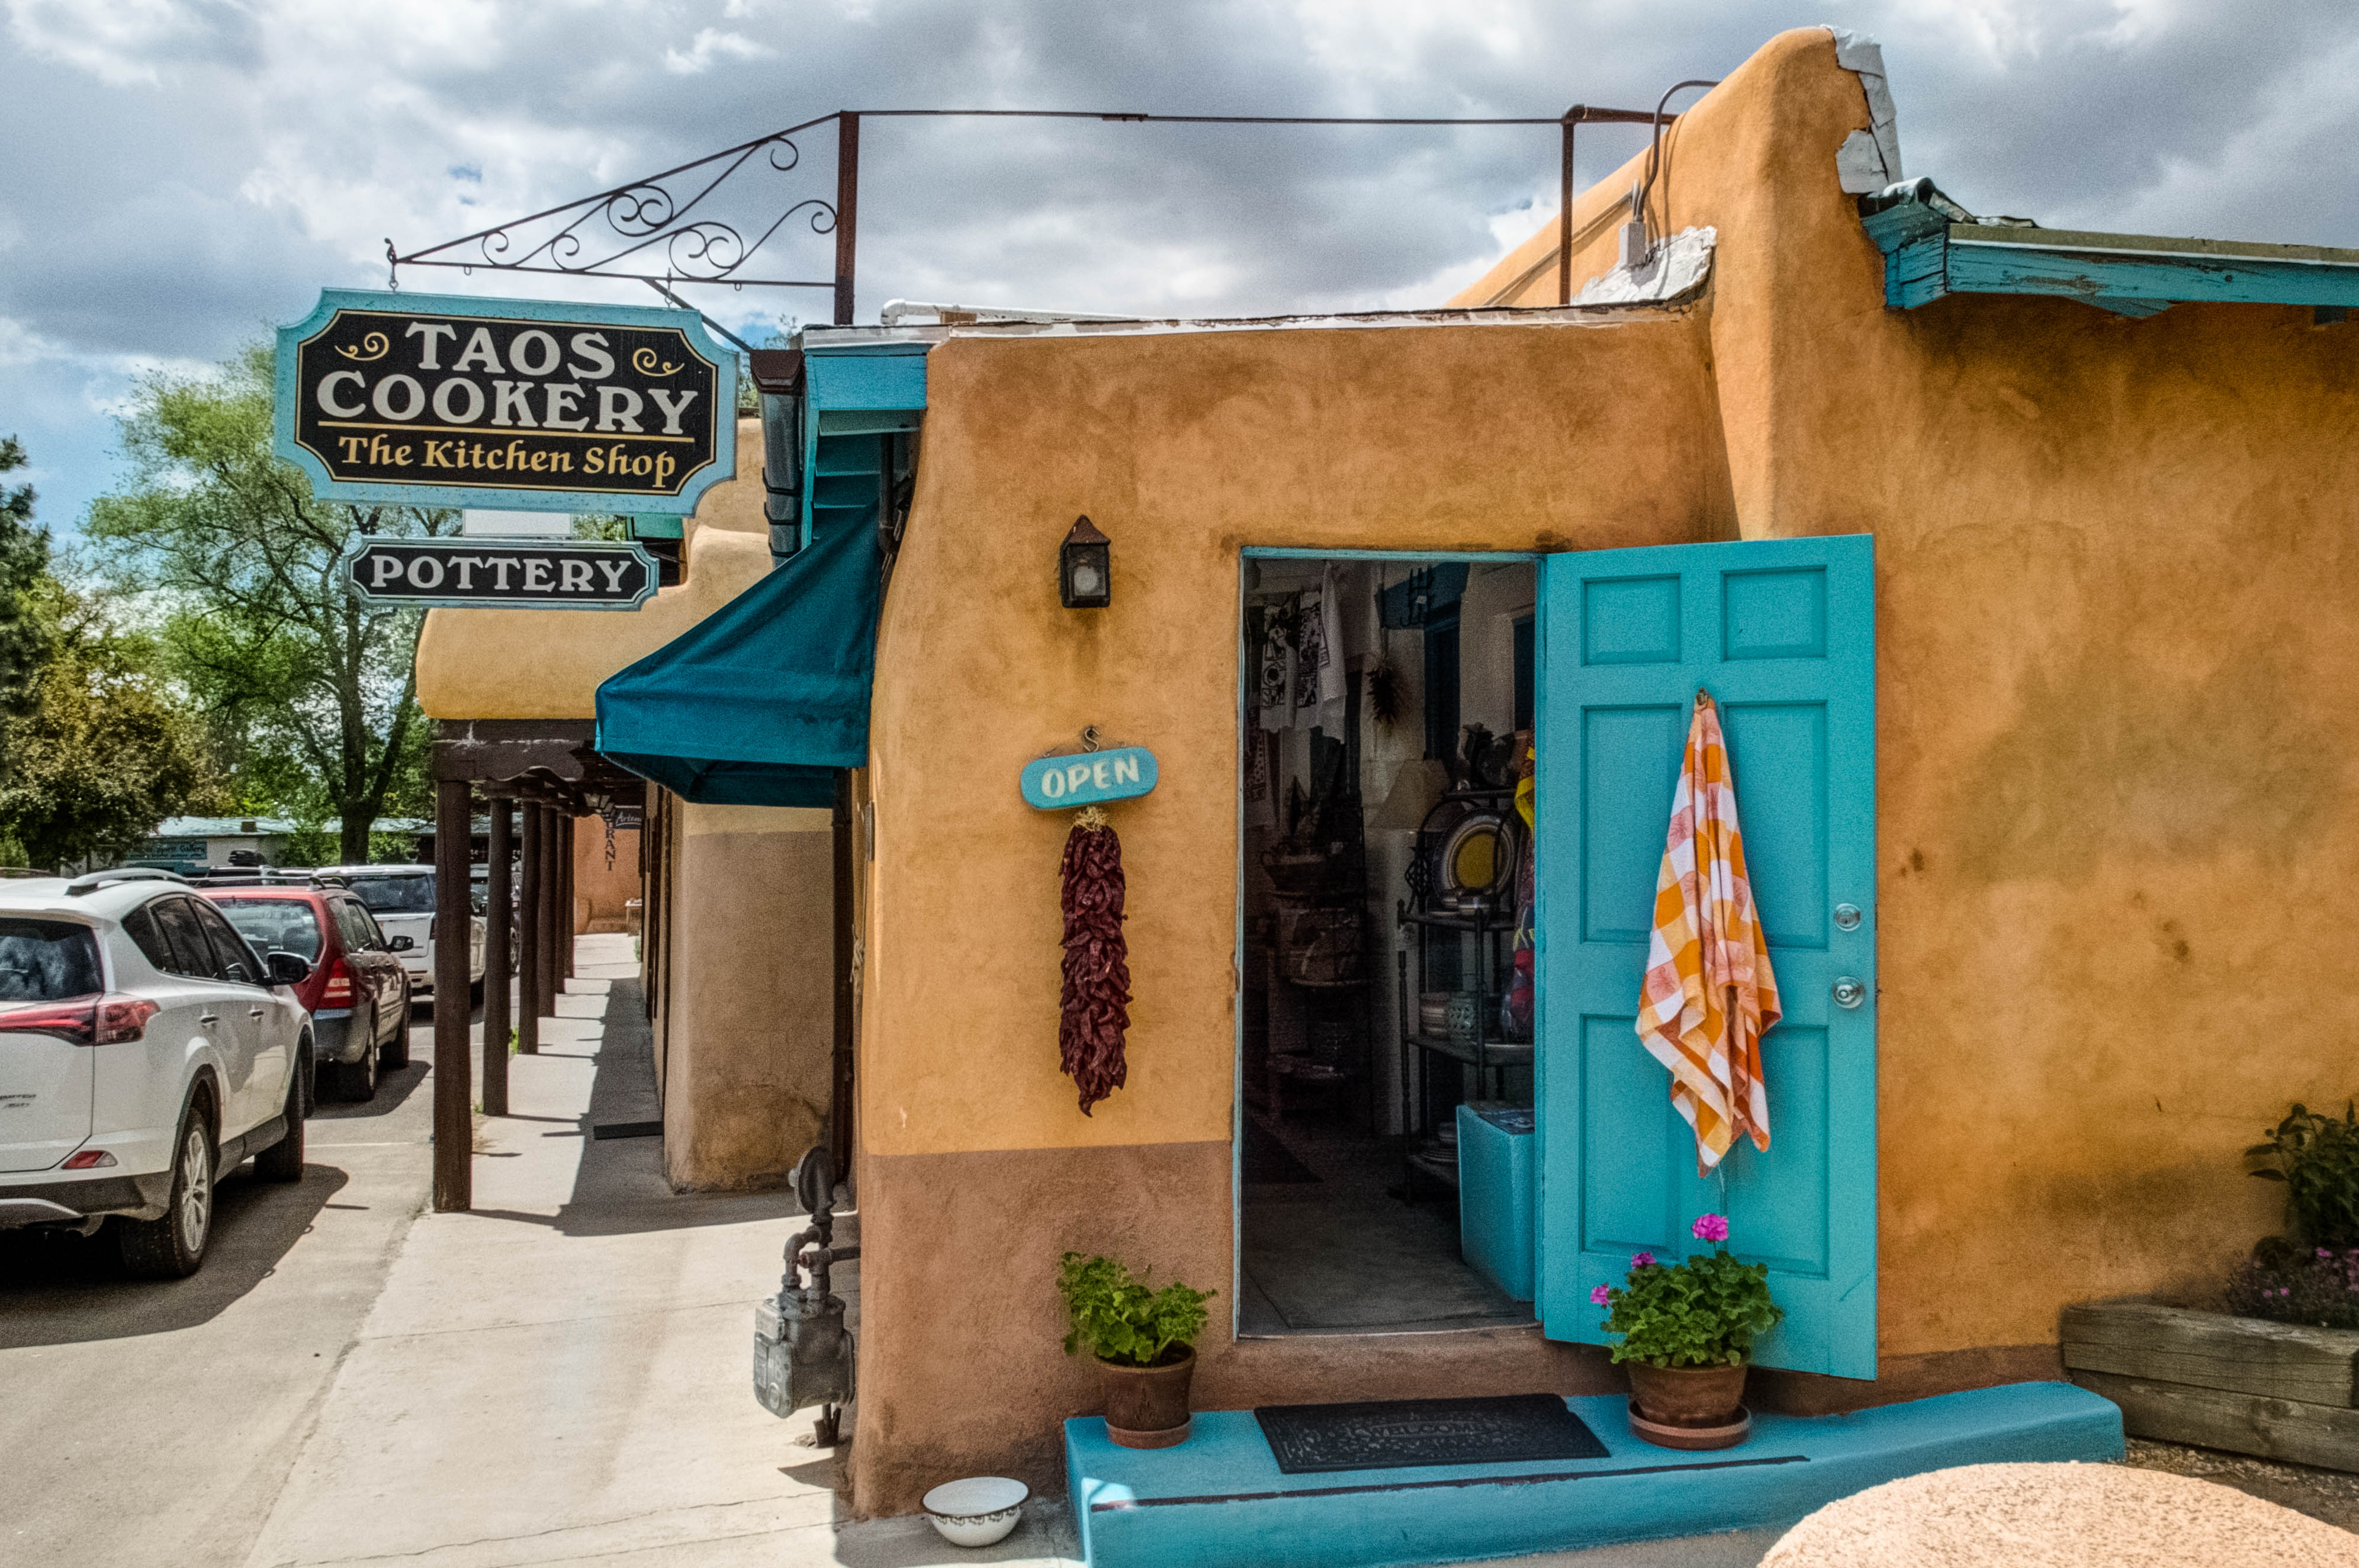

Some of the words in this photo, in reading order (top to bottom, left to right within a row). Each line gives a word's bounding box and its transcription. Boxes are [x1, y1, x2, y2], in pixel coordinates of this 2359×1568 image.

[405, 321, 616, 380] TAOS
[316, 370, 699, 436] COOKERY
[339, 433, 412, 467] The
[421, 439, 575, 473] Kitchen
[583, 444, 676, 489] Shop
[369, 554, 632, 593] POTTERY
[1041, 754, 1139, 798] OPEN
